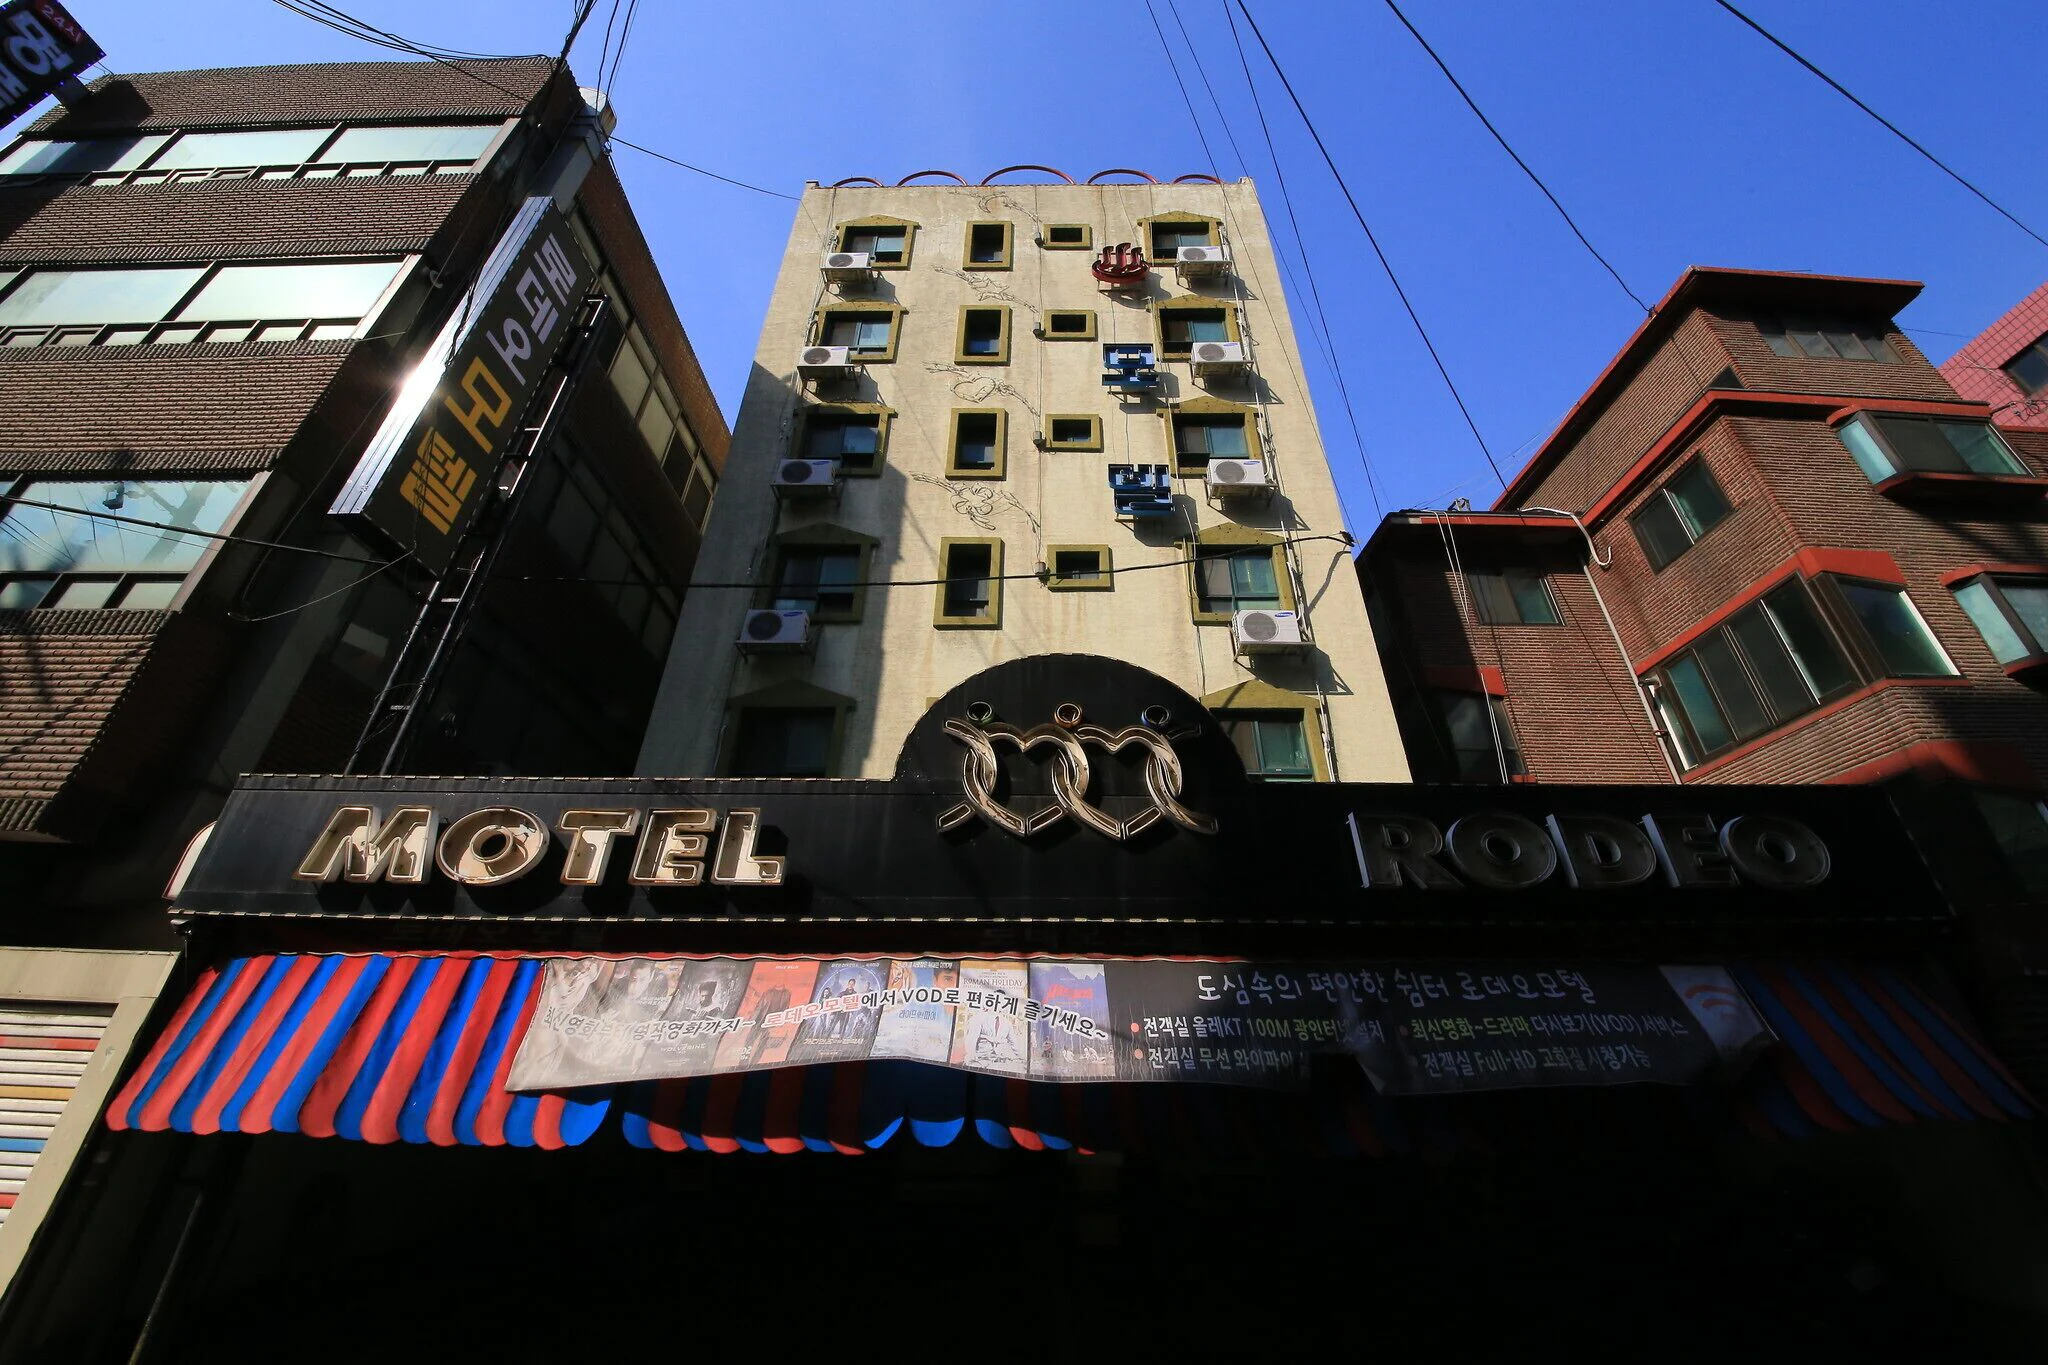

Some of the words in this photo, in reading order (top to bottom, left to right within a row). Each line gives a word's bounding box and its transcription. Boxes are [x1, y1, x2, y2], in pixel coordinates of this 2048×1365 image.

[41, 4, 83, 43] 24시
[293, 803, 788, 887] MOTEL
[1345, 811, 1832, 890] RODEO
[1197, 970, 1302, 1005] 도심속의
[1306, 968, 1388, 1003] 편안한
[1393, 968, 1450, 1008] 쉼터
[1455, 969, 1597, 1005] 로데오모텔
[902, 988, 960, 1004] VOD로
[966, 990, 1019, 1016] 편하게
[1024, 1000, 1107, 1038] 즐기세요~
[1143, 1016, 1190, 1038] 전객실
[1246, 1018, 1292, 1039] 100M
[1642, 1015, 1690, 1037] 서비스
[1148, 1047, 1197, 1069] 전객실
[1199, 1047, 1232, 1070] 무선
[1233, 1048, 1295, 1074] 와이파이
[1422, 1051, 1475, 1078] 전객실
[1474, 1049, 1537, 1073] Full-HD
